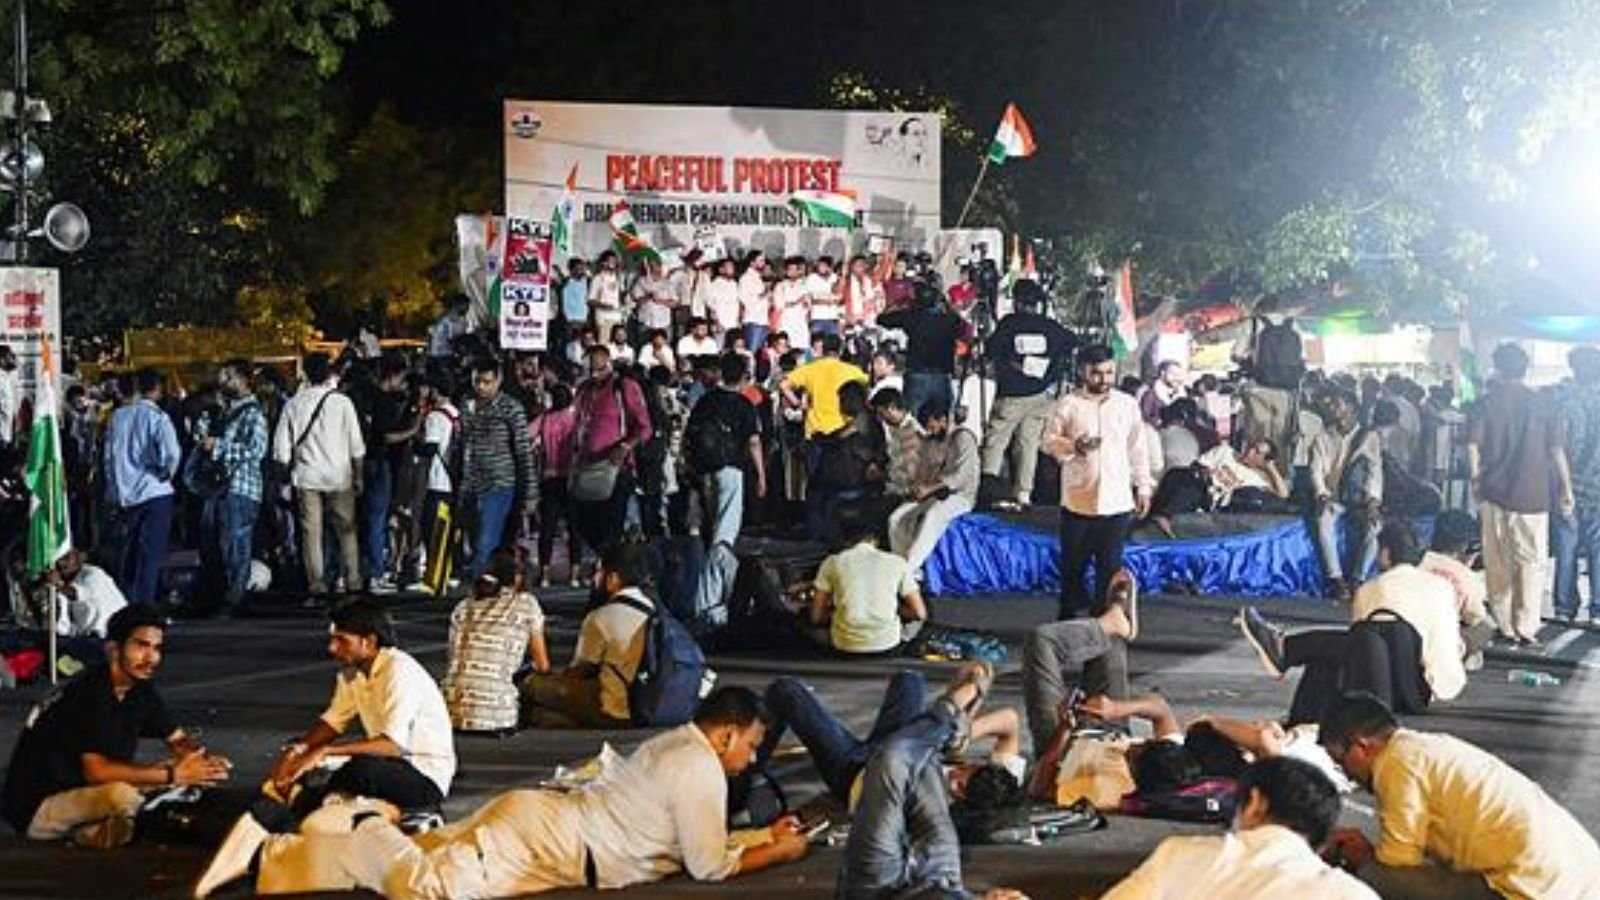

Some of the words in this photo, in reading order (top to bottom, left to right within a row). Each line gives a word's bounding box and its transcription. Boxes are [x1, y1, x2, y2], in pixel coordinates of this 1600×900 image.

[606, 154, 728, 193] PEACEFUL
[733, 157, 842, 194] PROTEST
[583, 203, 687, 226] DHAENDRA
[690, 204, 760, 226] PRADHAN
